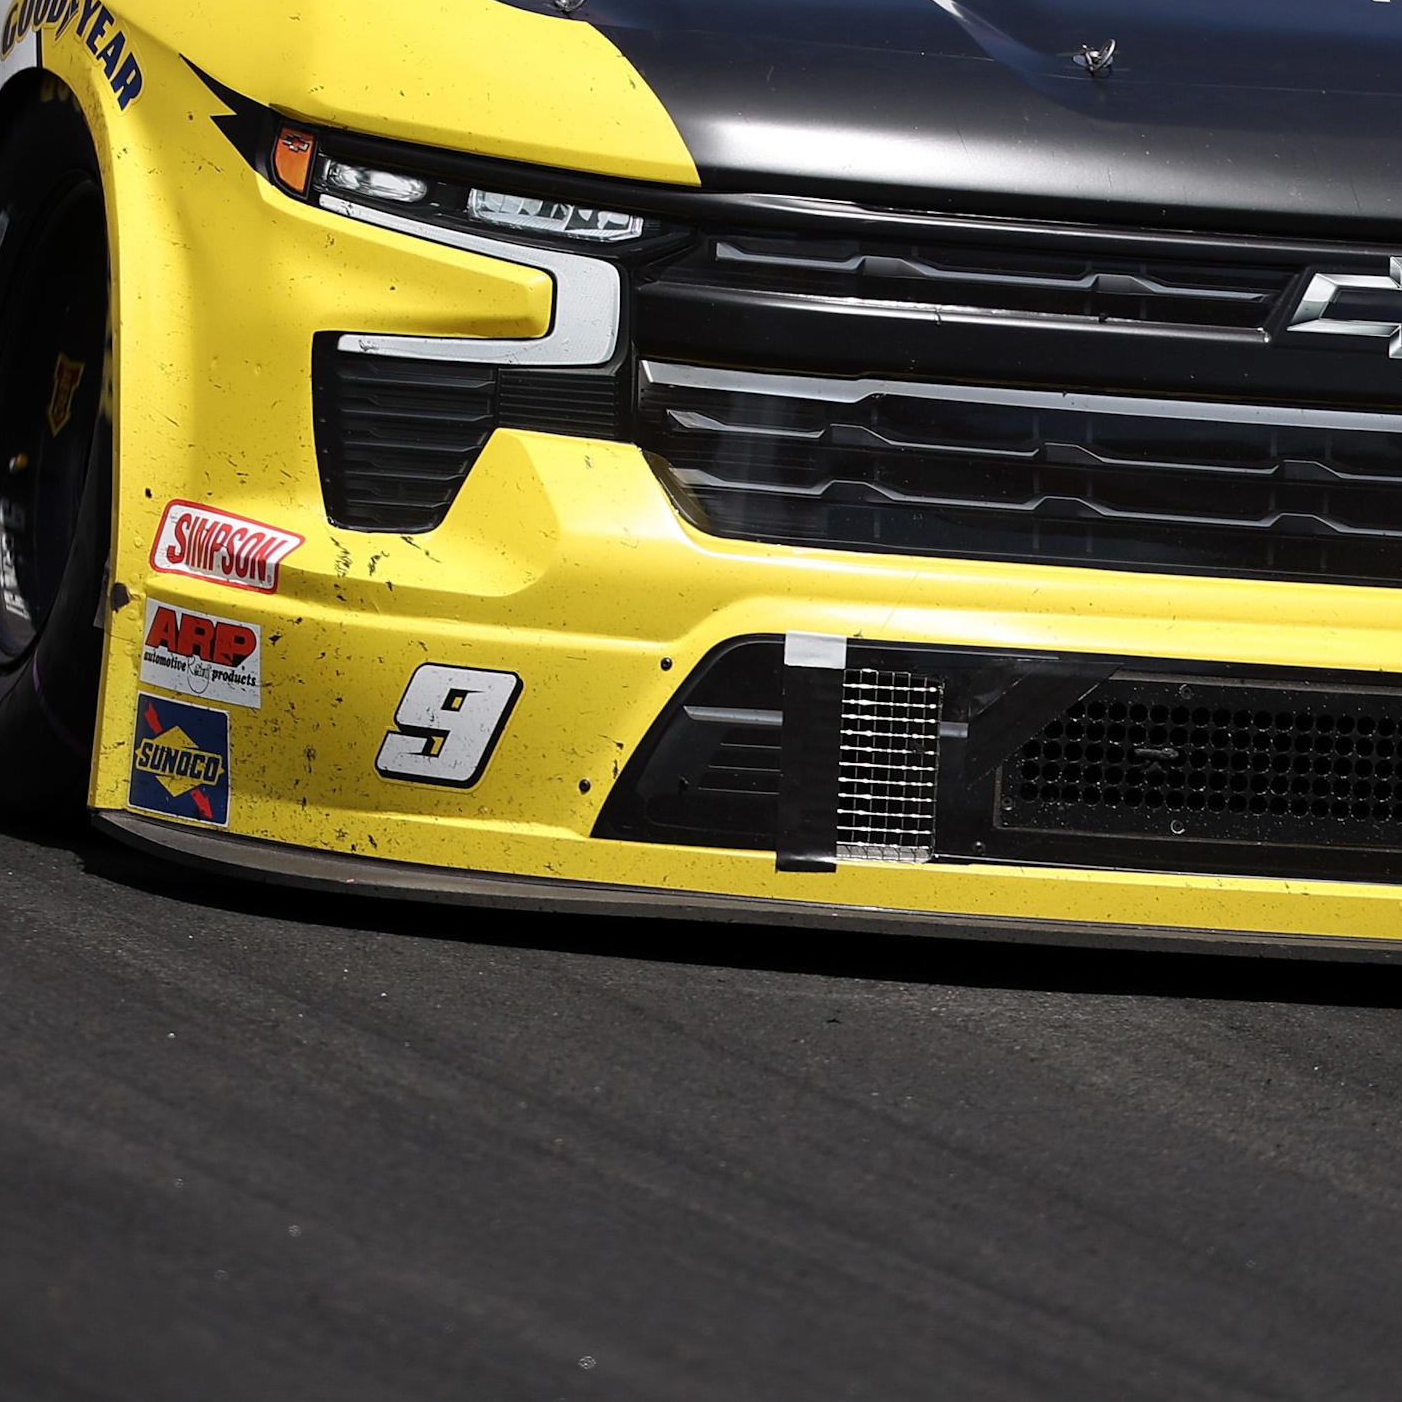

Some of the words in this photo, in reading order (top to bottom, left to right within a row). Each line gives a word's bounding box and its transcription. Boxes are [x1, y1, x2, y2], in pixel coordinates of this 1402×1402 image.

[165, 511, 292, 583] SIMPSON
[143, 648, 187, 674] automotive
[210, 666, 258, 688] products
[144, 604, 258, 668] ARP
[375, 662, 522, 788] 9
[136, 740, 224, 785] SUNOCO
